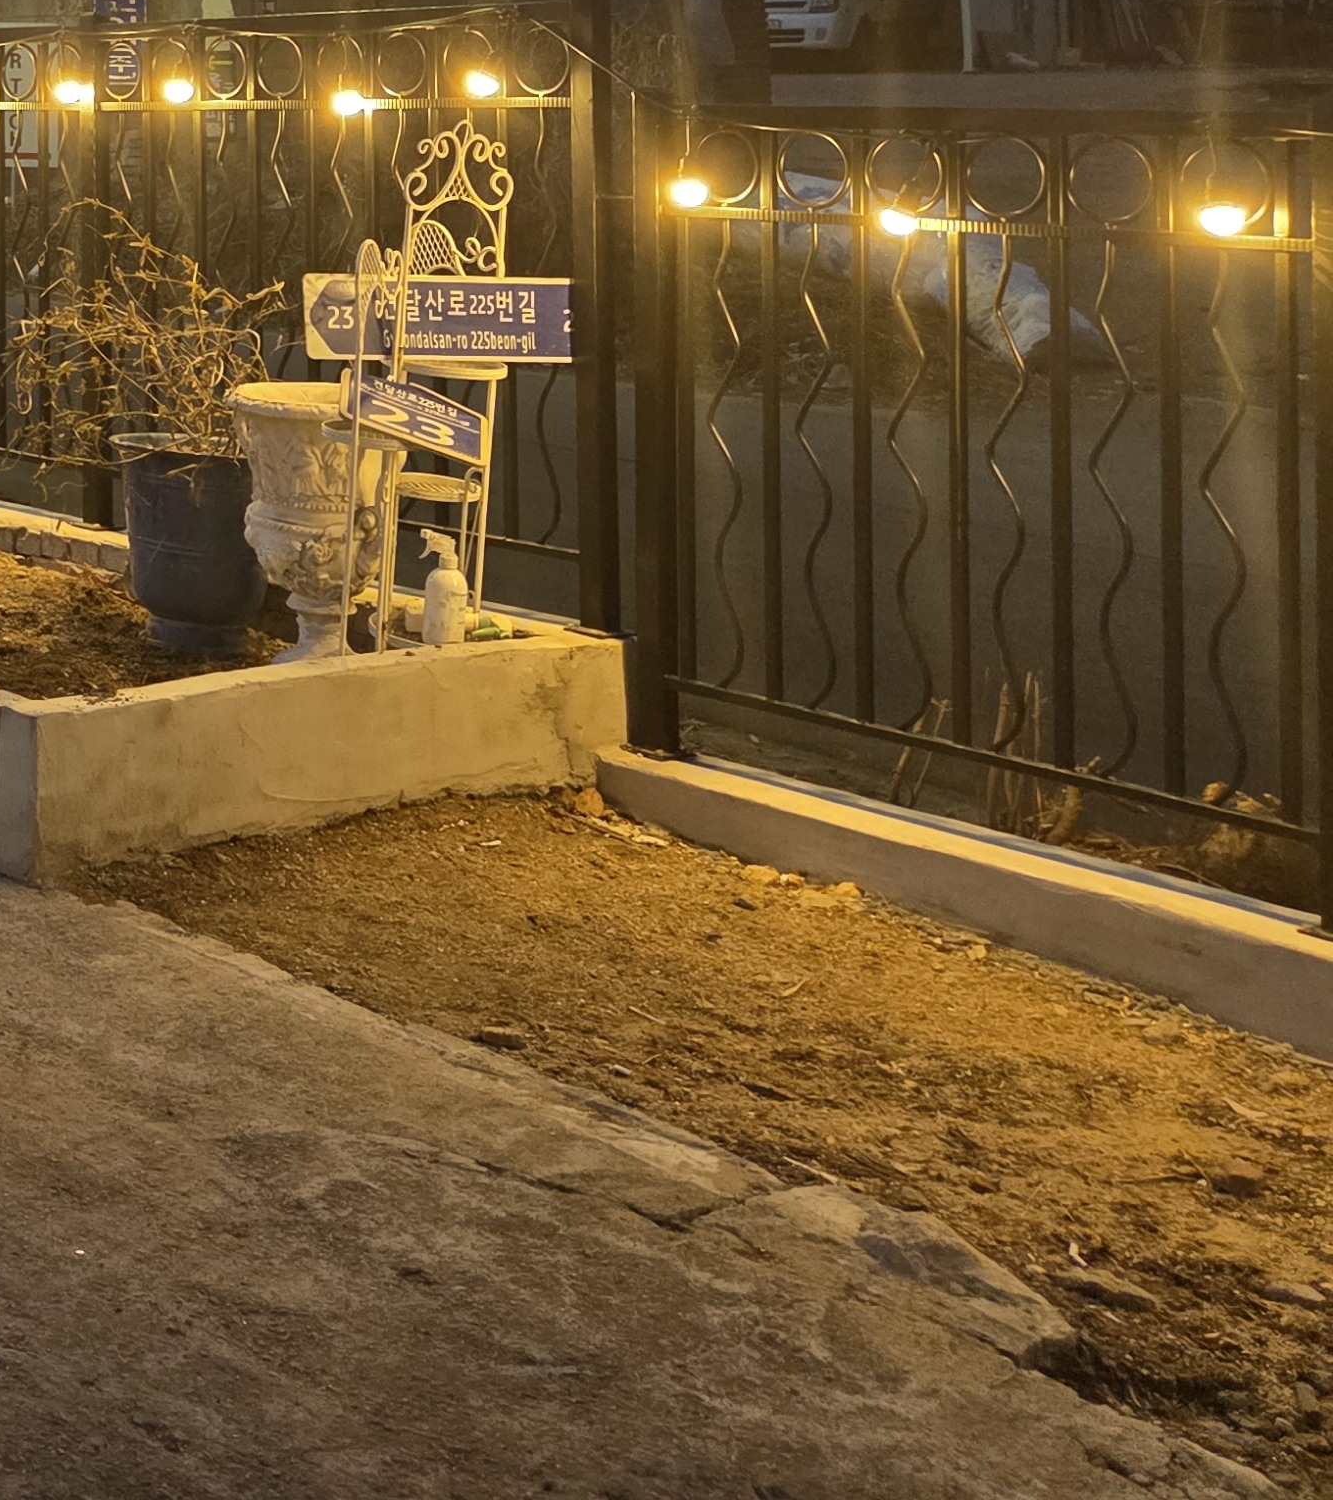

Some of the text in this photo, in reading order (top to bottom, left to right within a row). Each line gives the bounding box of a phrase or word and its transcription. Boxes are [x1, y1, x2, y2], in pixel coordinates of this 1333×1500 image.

[326, 305, 355, 330] 23
[471, 331, 536, 354] 225beon-gil
[368, 399, 455, 446] 23
